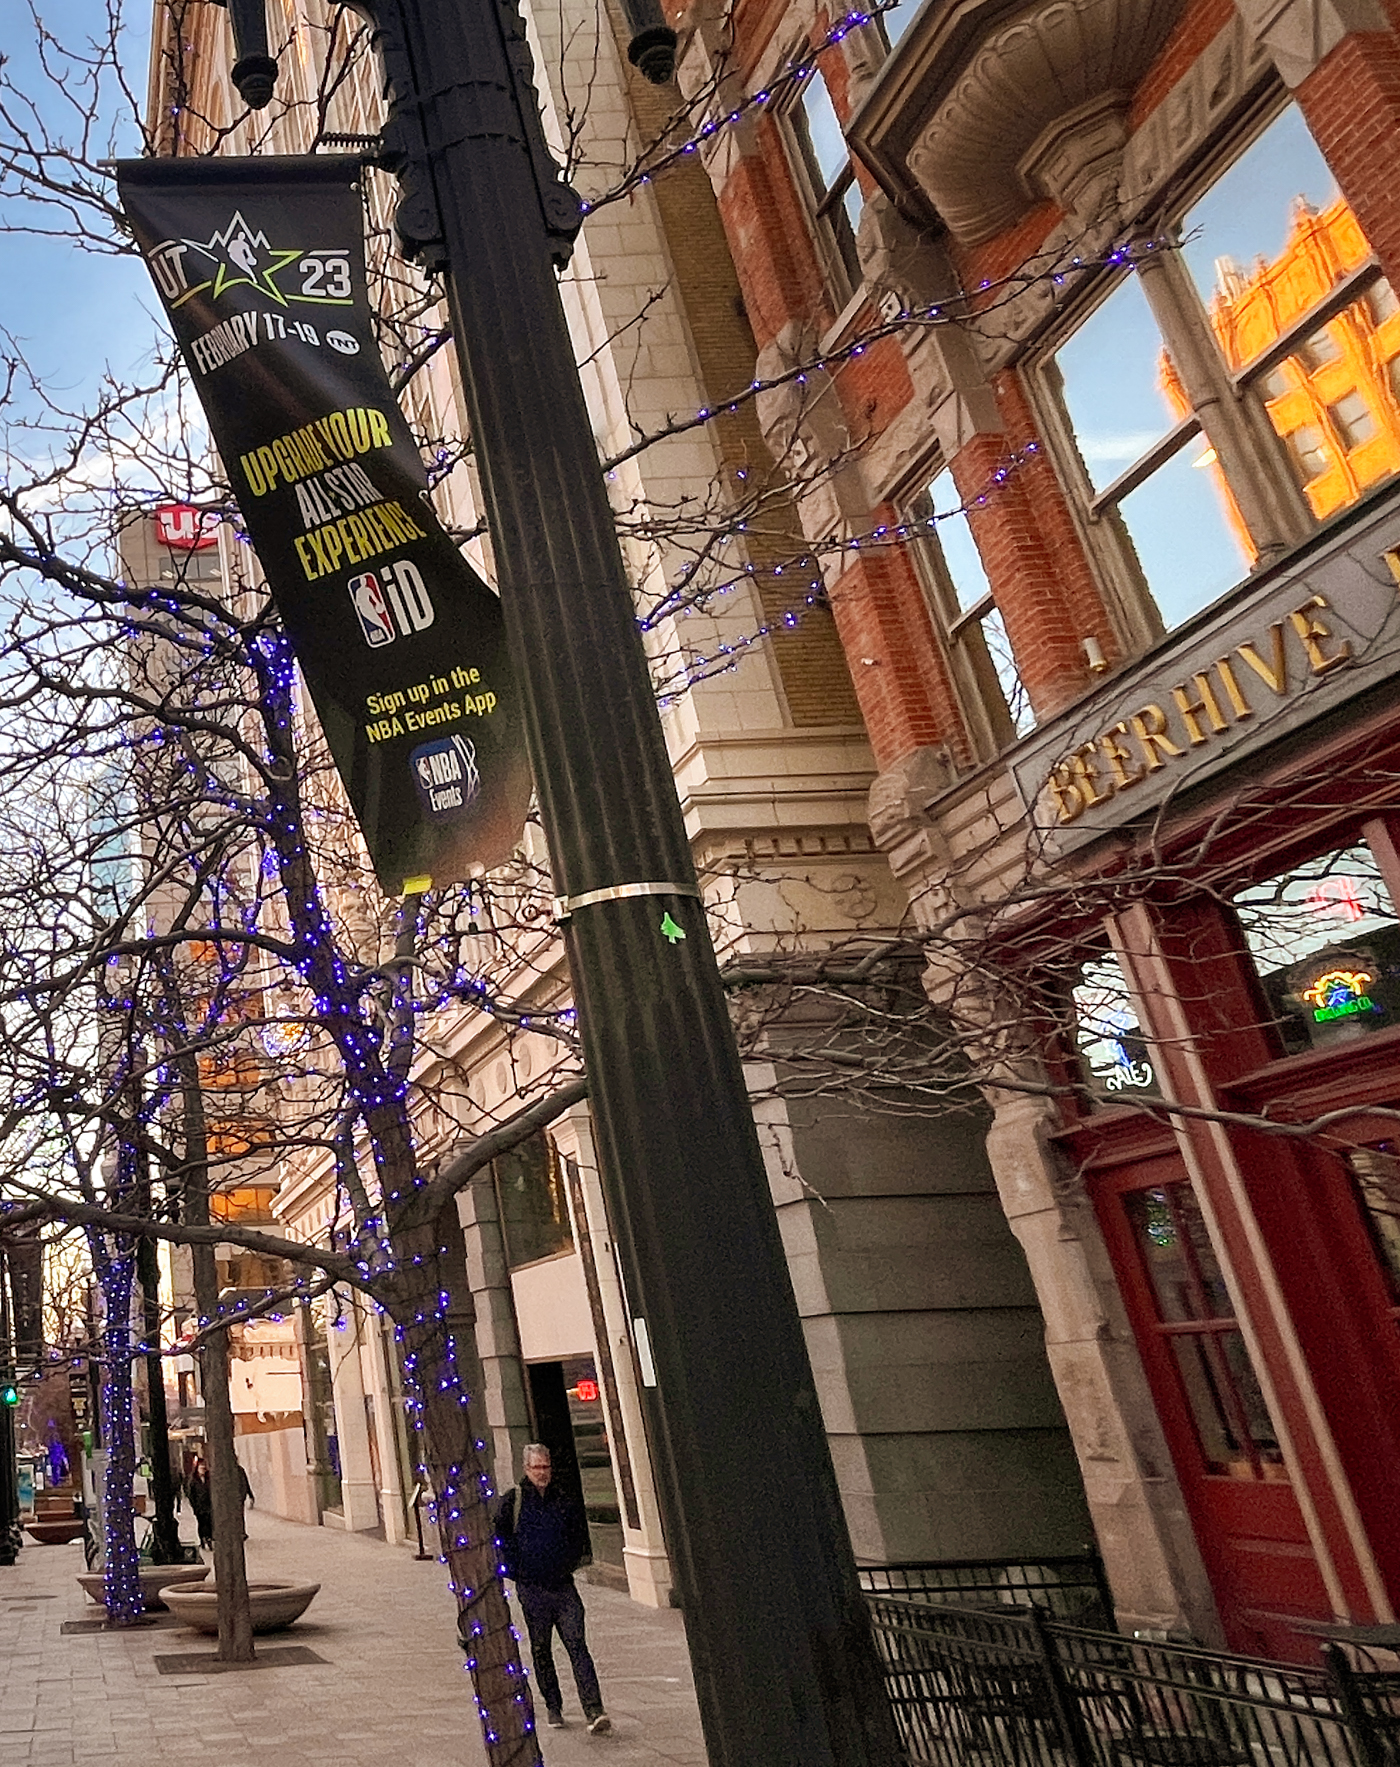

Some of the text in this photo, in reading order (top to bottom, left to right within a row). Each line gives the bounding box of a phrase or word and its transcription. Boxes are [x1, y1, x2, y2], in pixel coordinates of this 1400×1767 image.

[151, 245, 351, 299] UT 23
[190, 311, 258, 375] FEBRUARY
[262, 311, 321, 347] 17-19
[240, 408, 393, 497] UPGRADE YOUR
[294, 501, 428, 582] EXPERIENCE
[365, 691, 497, 743] NBA Events App
[366, 665, 481, 715] Sign up in the
[1049, 595, 1353, 825] BEERHIVE
[428, 749, 463, 812] NBA Events
